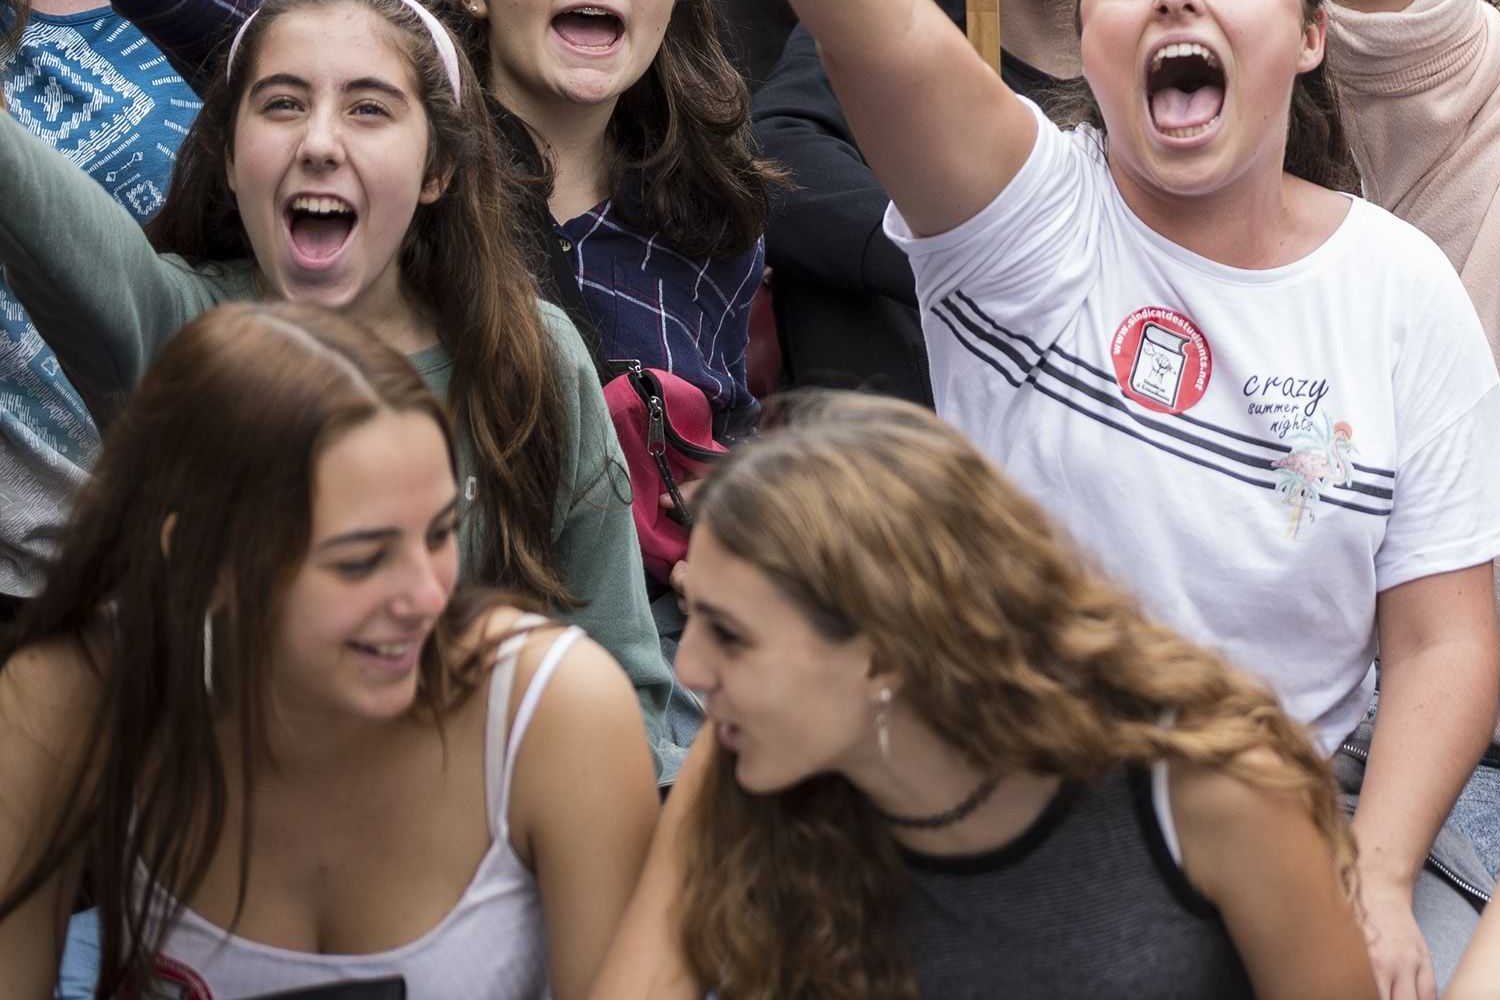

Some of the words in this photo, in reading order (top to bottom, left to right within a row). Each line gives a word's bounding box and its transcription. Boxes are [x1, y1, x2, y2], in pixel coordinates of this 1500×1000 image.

[1243, 375, 1329, 417] crazy
[1247, 402, 1299, 415] summer
[1270, 413, 1313, 439] nights
